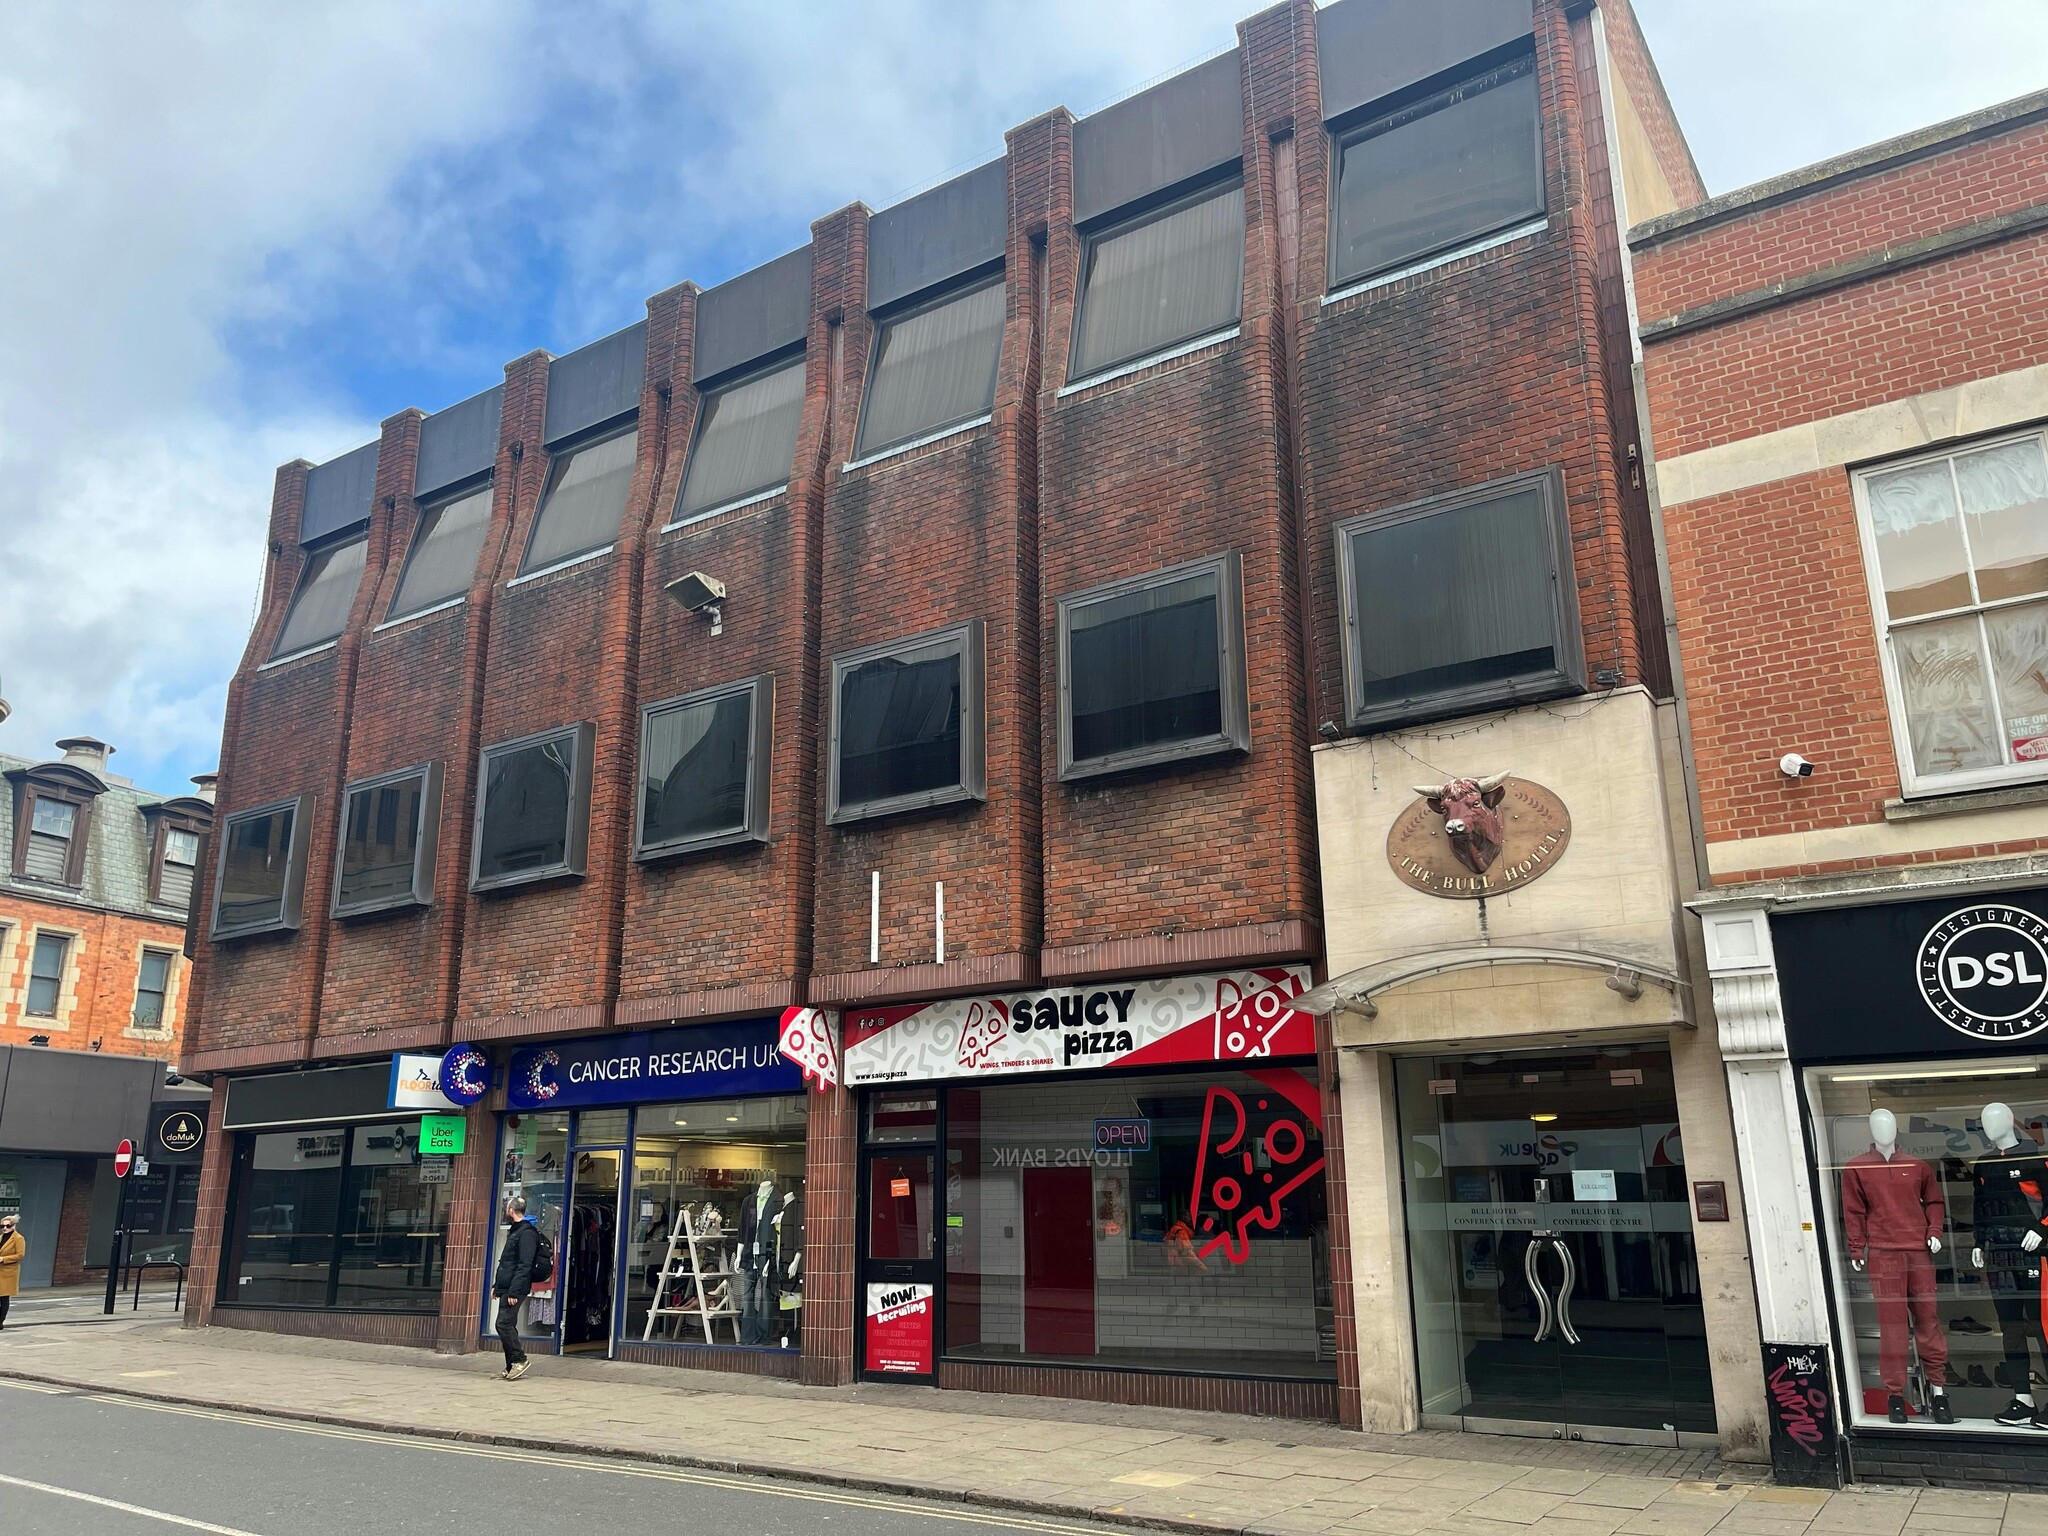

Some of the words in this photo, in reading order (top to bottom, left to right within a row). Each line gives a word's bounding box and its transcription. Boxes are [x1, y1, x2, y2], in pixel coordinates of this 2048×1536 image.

[2007, 717, 2029, 727] THE
[2010, 725, 2042, 738] SINCE
[1400, 854, 1433, 885] THE
[1443, 875, 1495, 890] BULL
[1504, 834, 1561, 882] HOTEL
[1935, 909, 2043, 942] DESIGNER
[1947, 950, 2043, 990] DSL
[1923, 960, 2015, 1034] LIFESTYLE
[1063, 1030, 1133, 1066] pizza
[569, 1056, 641, 1084] CANCER
[648, 1046, 747, 1077] RESEARCH
[753, 1044, 781, 1068] UK
[1001, 1059, 1025, 1068] TENDERS
[1031, 1057, 1054, 1067] SHAKES
[855, 1070, 908, 1081] www.saucy.pizza
[166, 1133, 195, 1142] doMuk
[431, 1127, 454, 1137] Uber
[1096, 1125, 1147, 1145] OPEN
[430, 1138, 454, 1148] Eats
[1471, 1207, 1492, 1215] BULL
[1493, 1207, 1519, 1215] HOTEL
[1454, 1217, 1505, 1225] CONFERENCE
[1506, 1217, 1538, 1225] CENTRE
[1552, 1218, 1608, 1226] CONFERENCE
[1609, 1218, 1644, 1226] CENTRE
[880, 1285, 917, 1310] NOW!
[876, 1300, 927, 1325] Recruiting
